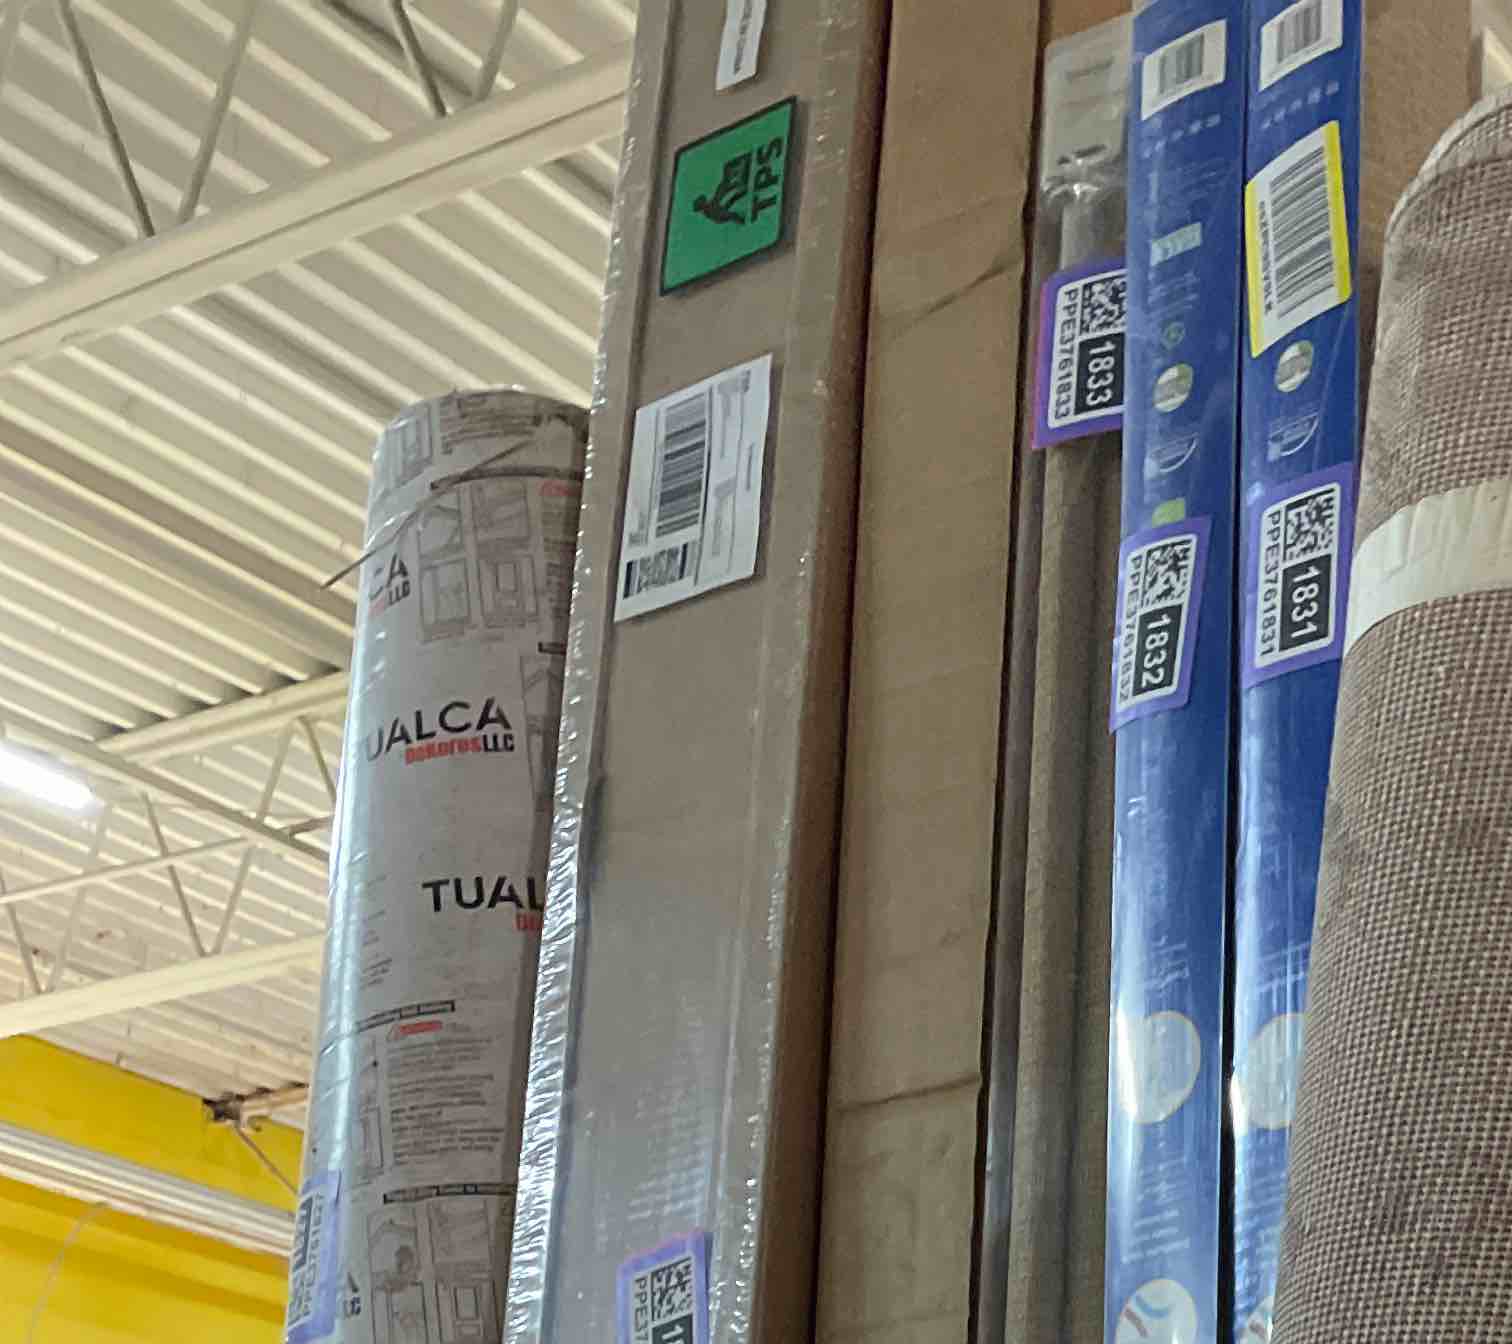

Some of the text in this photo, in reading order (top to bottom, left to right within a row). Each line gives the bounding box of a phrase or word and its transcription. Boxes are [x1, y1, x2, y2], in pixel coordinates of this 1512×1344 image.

[750, 137, 783, 223] TPS
[1054, 287, 1079, 420] PPE3761833
[1085, 340, 1116, 406] 1833
[1260, 508, 1282, 656] PPE3761831
[1290, 565, 1321, 639] 1831
[1141, 612, 1172, 688] 1832
[366, 696, 513, 762] UALCA
[421, 875, 544, 913] TUAL
